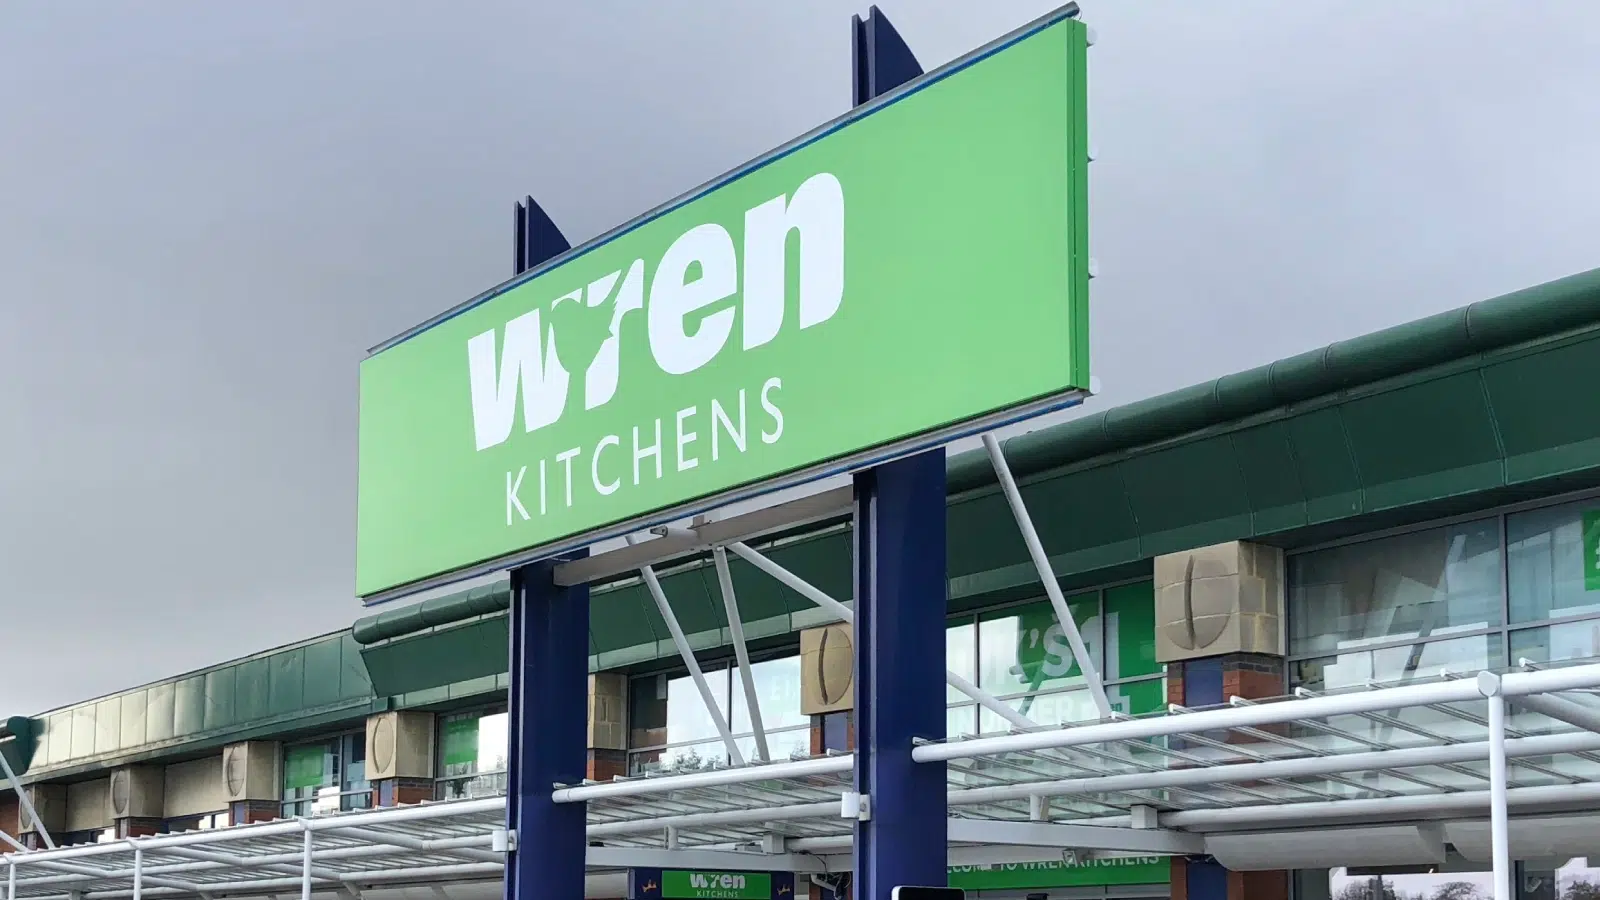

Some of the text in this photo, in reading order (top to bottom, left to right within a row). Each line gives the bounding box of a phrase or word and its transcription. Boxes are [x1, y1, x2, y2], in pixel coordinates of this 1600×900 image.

[467, 172, 845, 452] wren
[506, 376, 785, 526] KITCHENS
[690, 873, 746, 889] wren
[696, 889, 739, 898] KITCHENS
